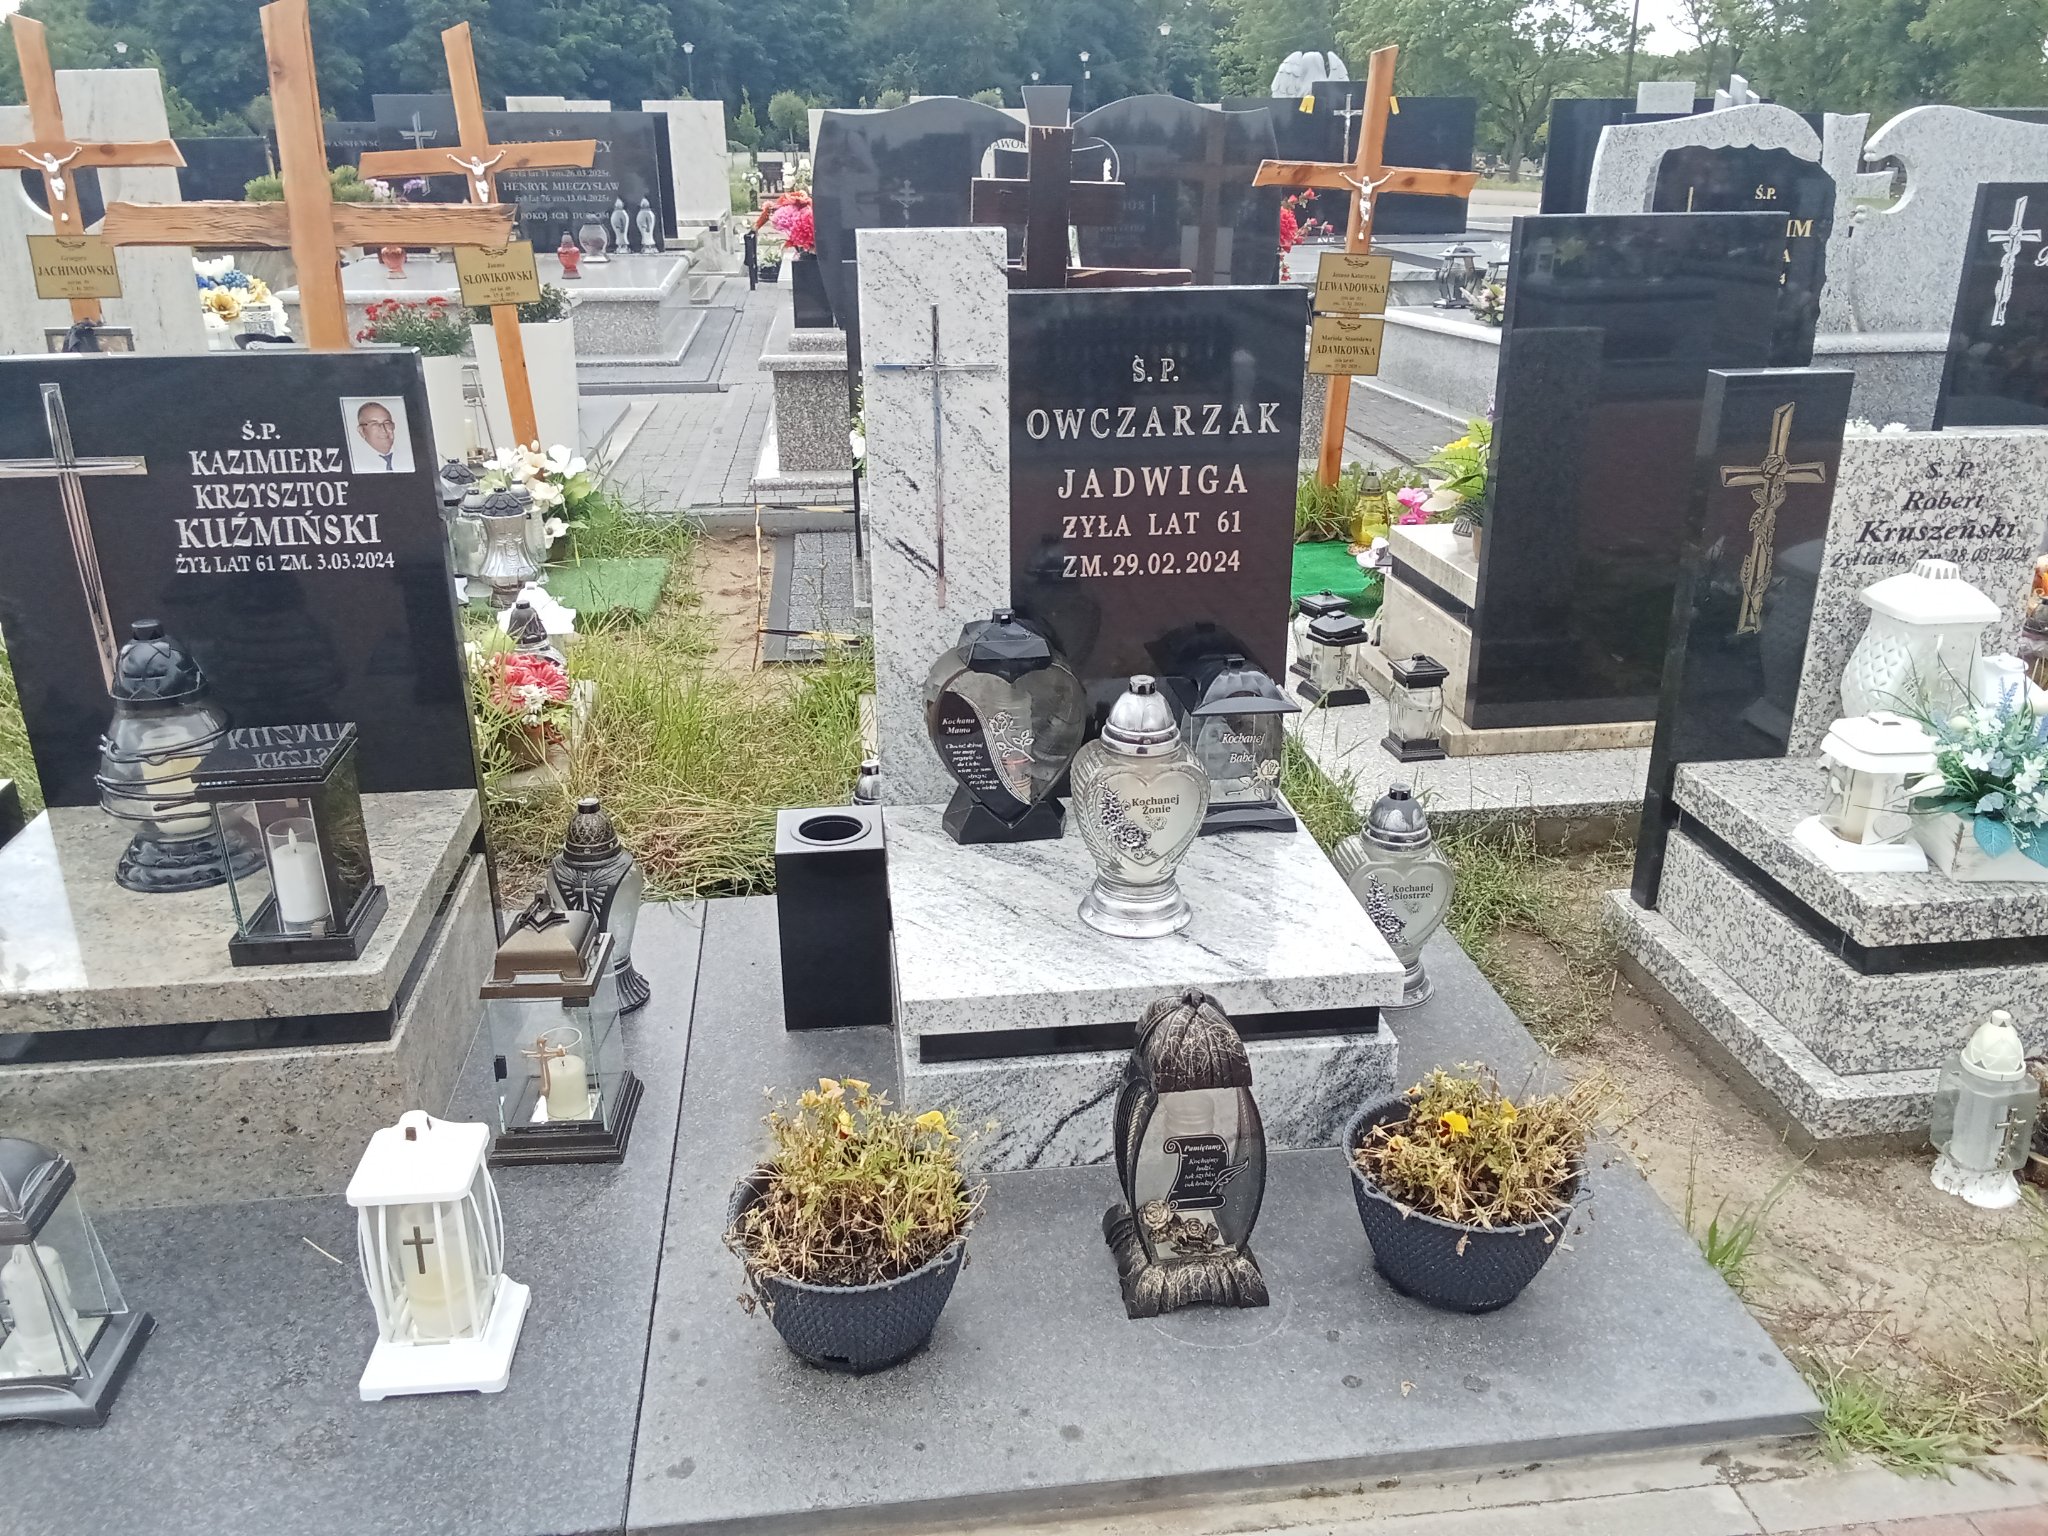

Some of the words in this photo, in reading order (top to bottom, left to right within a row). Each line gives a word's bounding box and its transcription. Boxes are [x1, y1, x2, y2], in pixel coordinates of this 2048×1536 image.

[503, 181, 548, 191] HENRYK
[38, 265, 115, 276] JACHIMOWSKI
[1319, 281, 1385, 294] LEWANDOWSKA
[1316, 344, 1376, 356] ADAMKOWSKA
[240, 420, 281, 440] Ś.P.
[1026, 402, 1281, 440] OWCZARZAK
[189, 448, 343, 476] KAZIMIERZ
[1058, 463, 1248, 499] JADWIGA
[193, 481, 349, 509] KRZYSZTOF
[1902, 490, 1985, 511] Robert
[175, 510, 382, 549] KUŹMIŃSKI
[1148, 511, 1200, 536] LAT
[1217, 510, 1242, 533] 61
[1856, 516, 2016, 544] Kruszeński
[175, 553, 212, 573] ŻYŁ
[214, 555, 251, 572] LAT
[255, 554, 276, 571] 61
[280, 554, 313, 571] ZM.
[317, 552, 396, 570] 3.03.2024
[1229, 752, 1257, 763] Babci
[1132, 795, 1180, 807] Kochanej
[1142, 805, 1171, 815] Żonie
[1392, 883, 1434, 893] Kochanej
[1394, 892, 1431, 900] Siostrze
